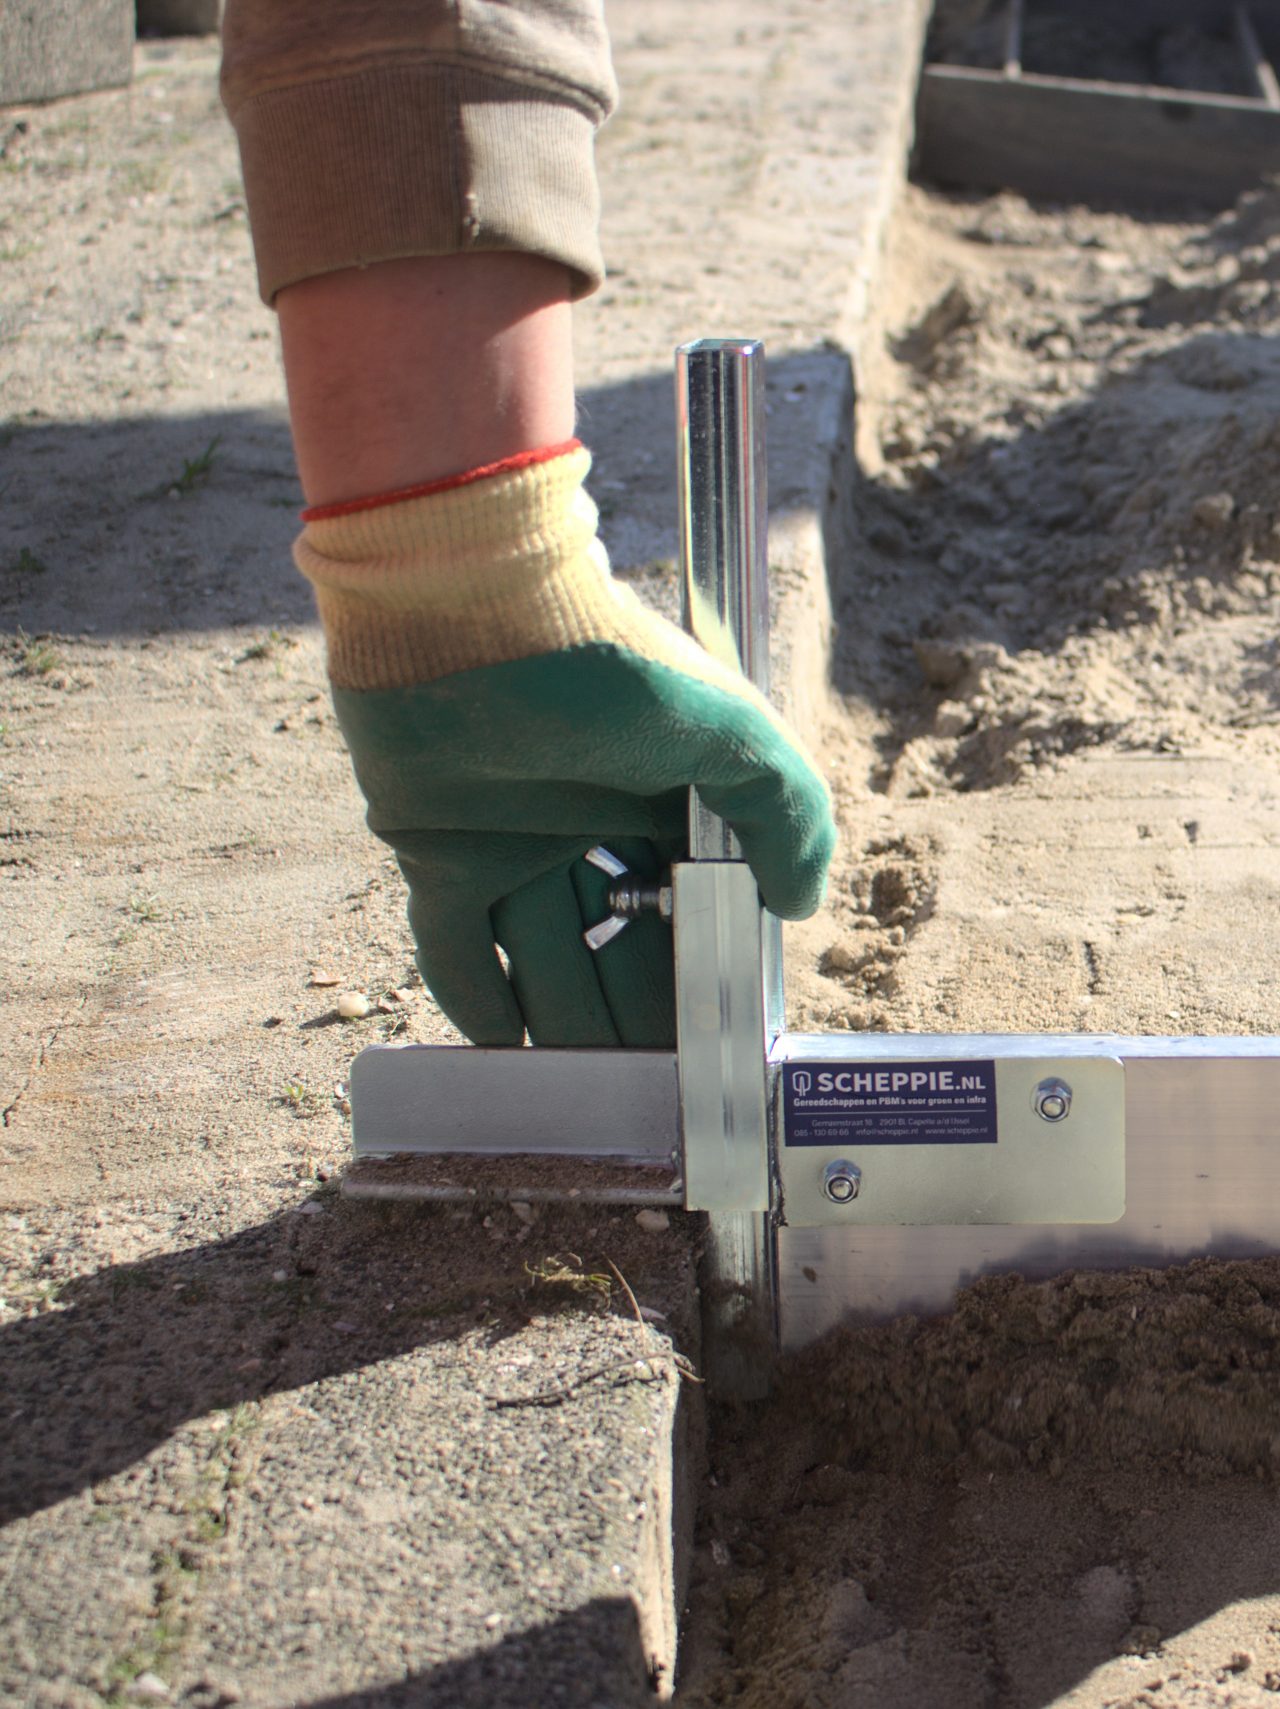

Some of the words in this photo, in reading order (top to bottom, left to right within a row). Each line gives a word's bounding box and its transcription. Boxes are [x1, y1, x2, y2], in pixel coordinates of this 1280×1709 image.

[817, 1071, 986, 1092] SCHEPPIE.NL
[793, 1097, 865, 1108] Gereedschappen
[866, 1098, 877, 1106] en
[878, 1096, 906, 1106] PBM's
[928, 1098, 953, 1107] groen
[954, 1097, 965, 1105] en
[966, 1095, 987, 1104] infra
